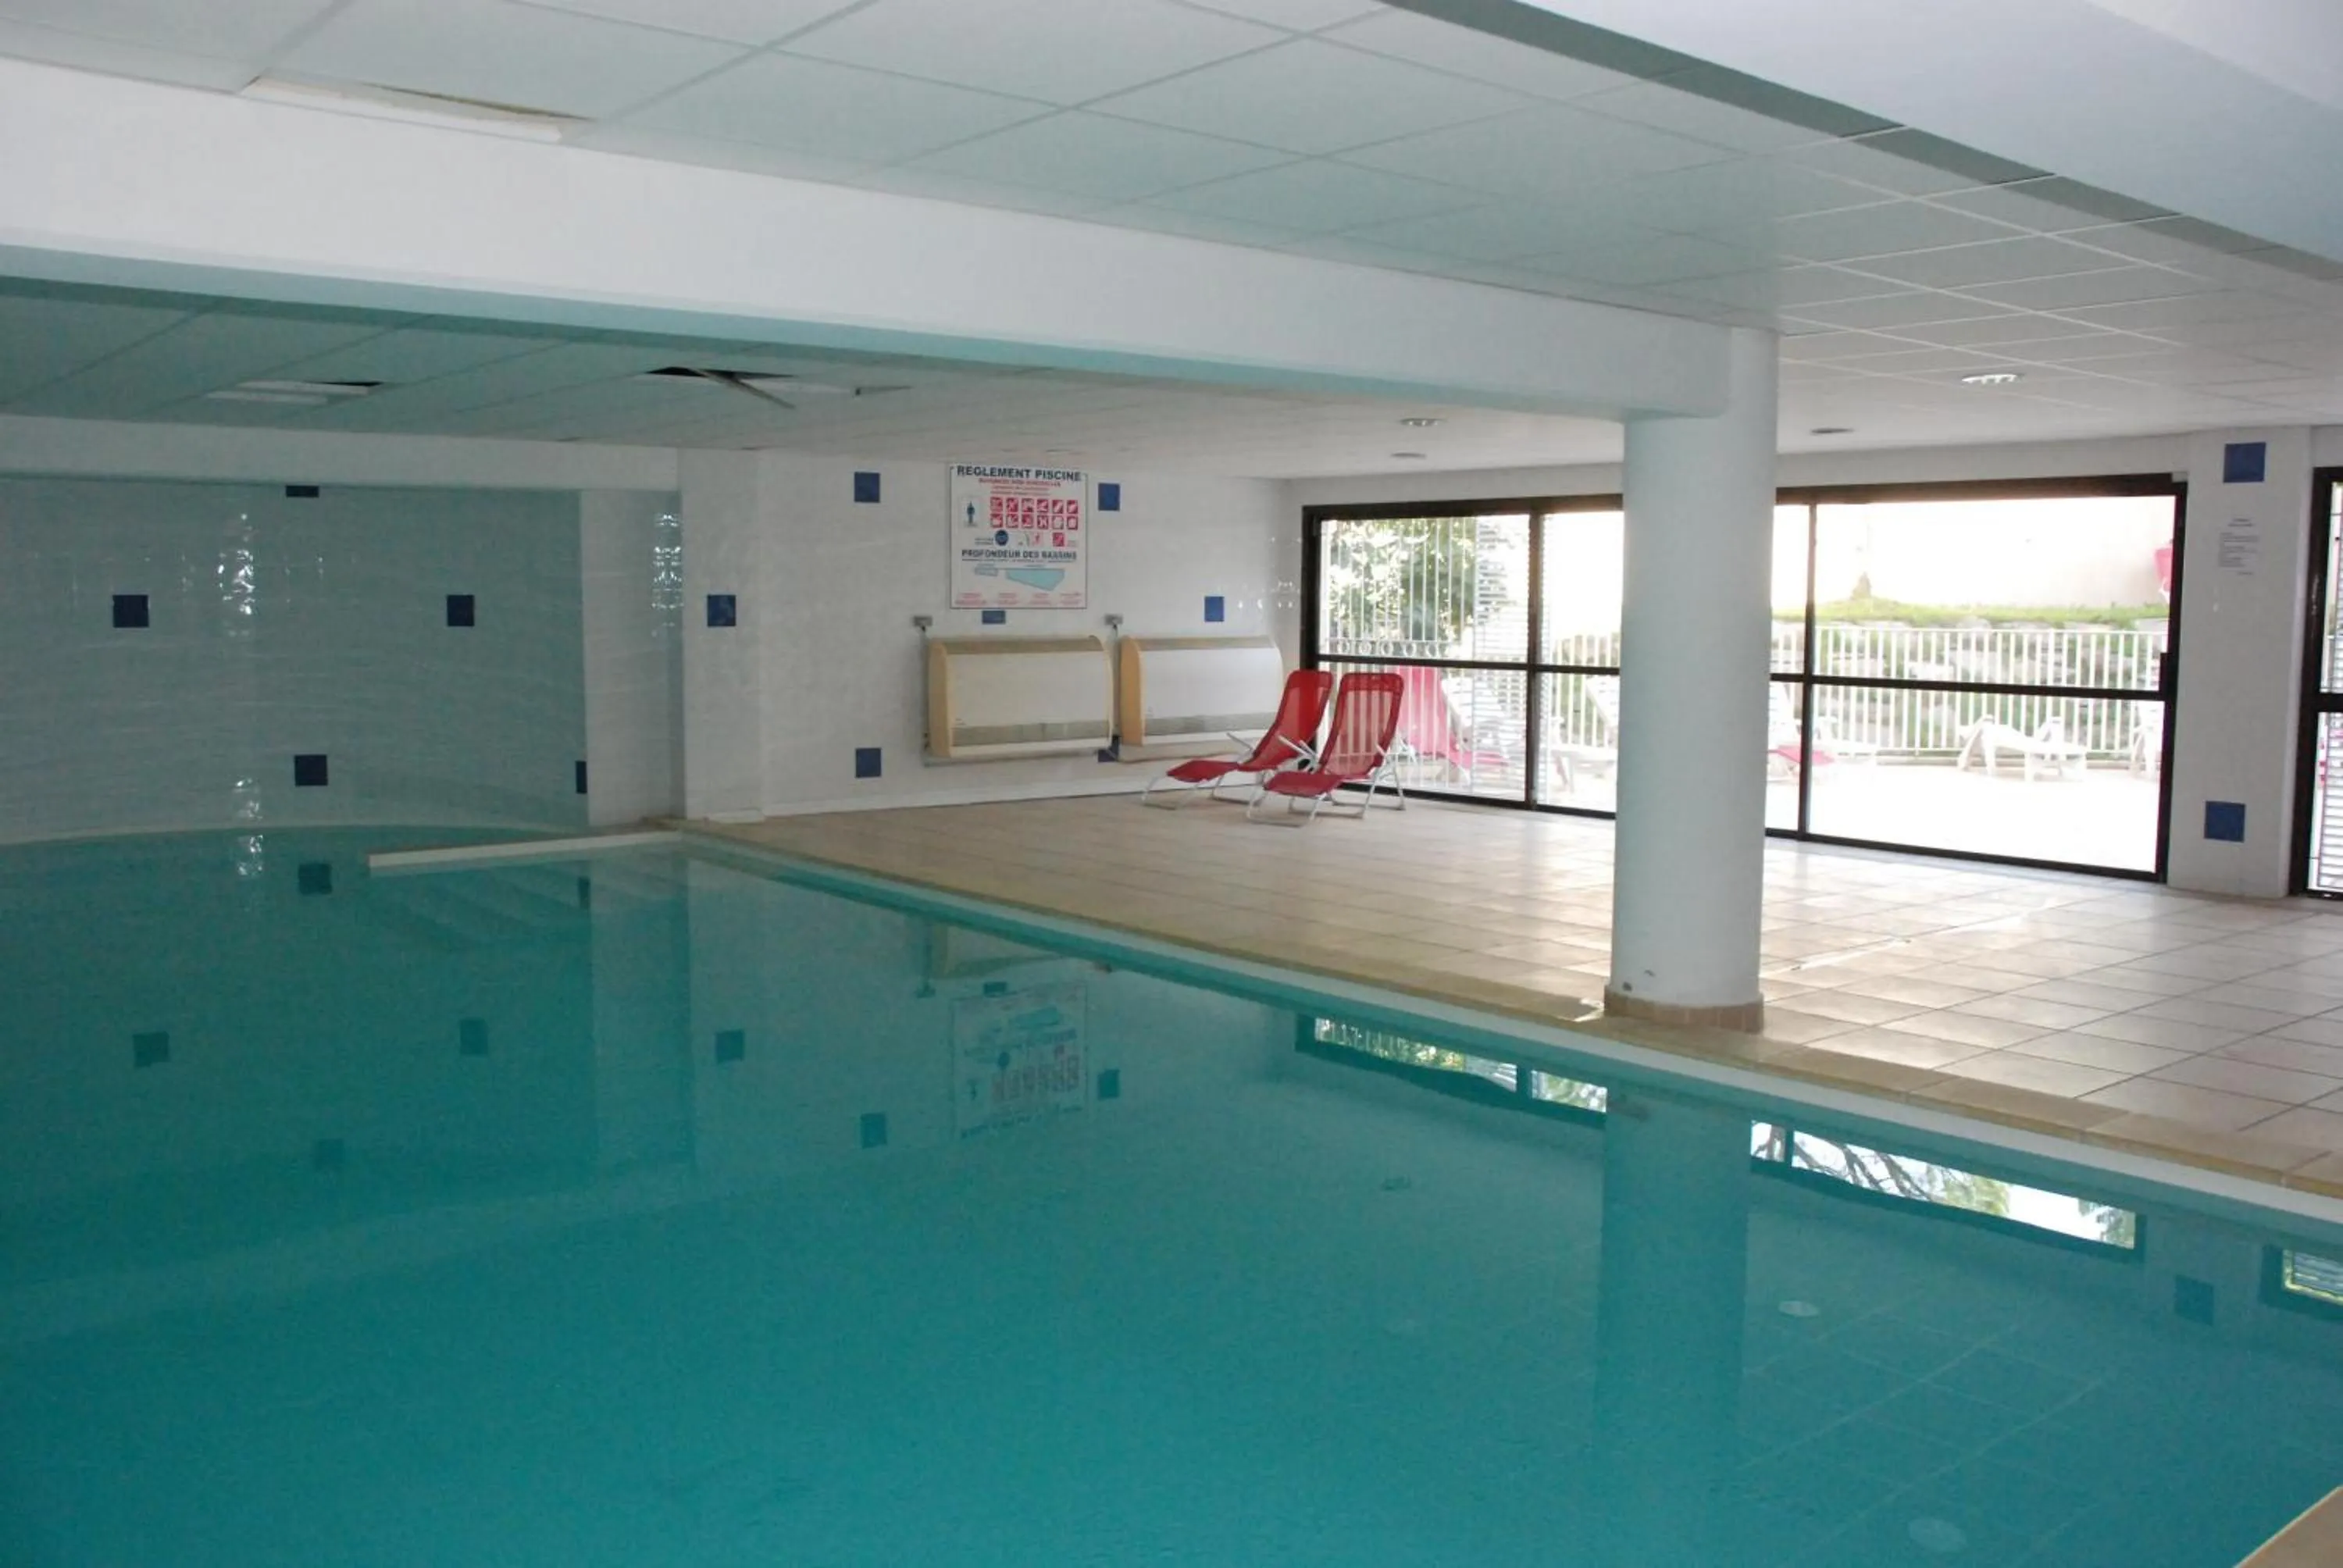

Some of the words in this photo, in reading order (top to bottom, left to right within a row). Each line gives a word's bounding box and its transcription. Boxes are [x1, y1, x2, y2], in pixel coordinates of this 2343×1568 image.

[957, 465, 1031, 479] REGLEMENT
[1036, 469, 1082, 482] PISCINE
[961, 549, 1022, 558] PROFONDEUR
[1042, 551, 1077, 560] BASSINS
